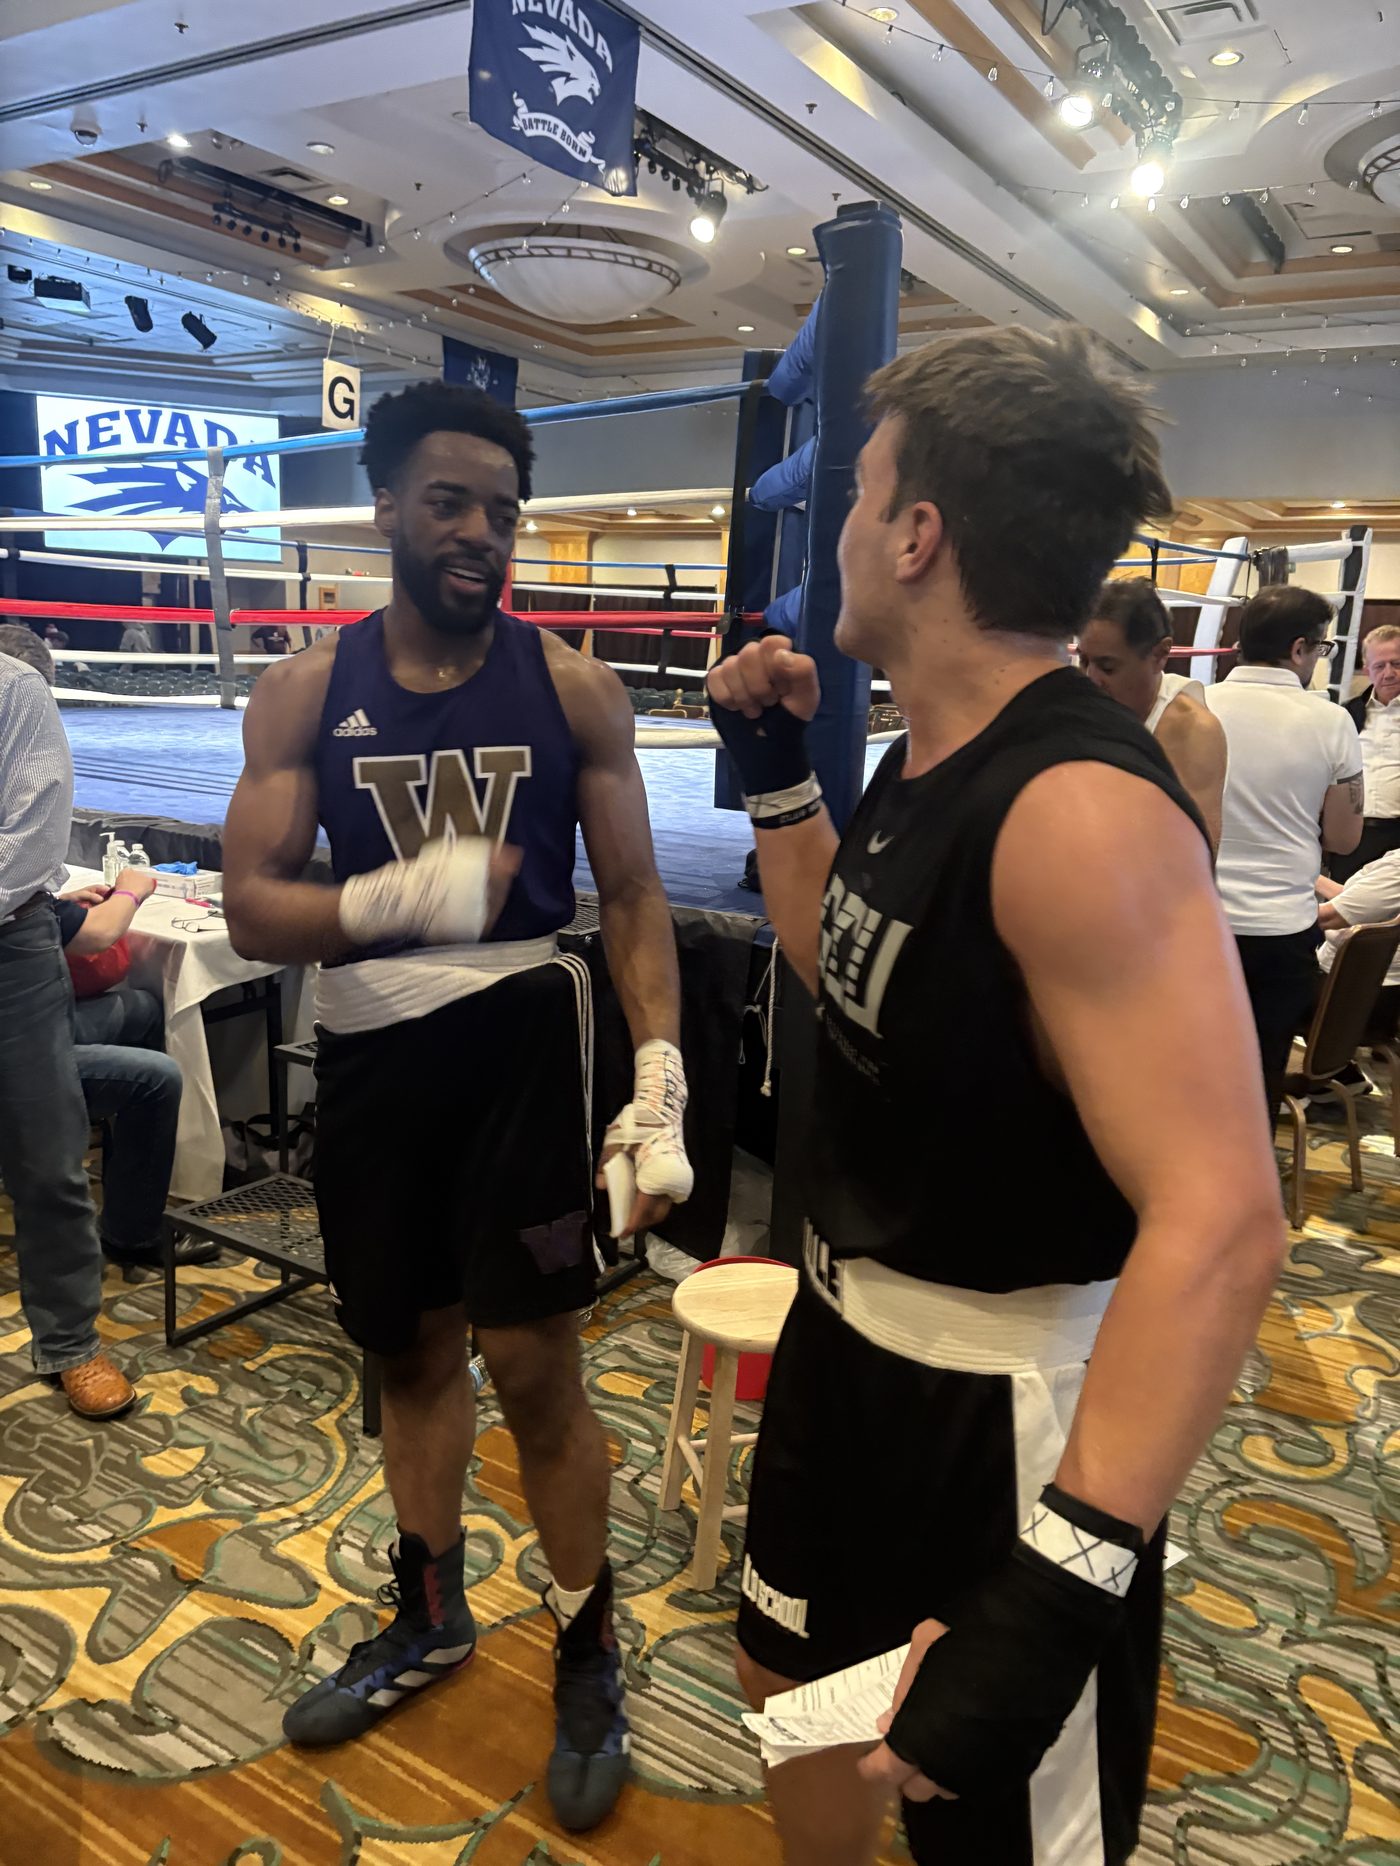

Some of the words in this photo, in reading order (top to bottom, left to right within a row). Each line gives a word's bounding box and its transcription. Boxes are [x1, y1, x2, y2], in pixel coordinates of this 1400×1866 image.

[522, 117, 560, 135] BATTLE
[560, 131, 588, 159] BORN
[328, 376, 355, 421] G
[333, 727, 378, 737] adidas
[353, 745, 532, 864] W
